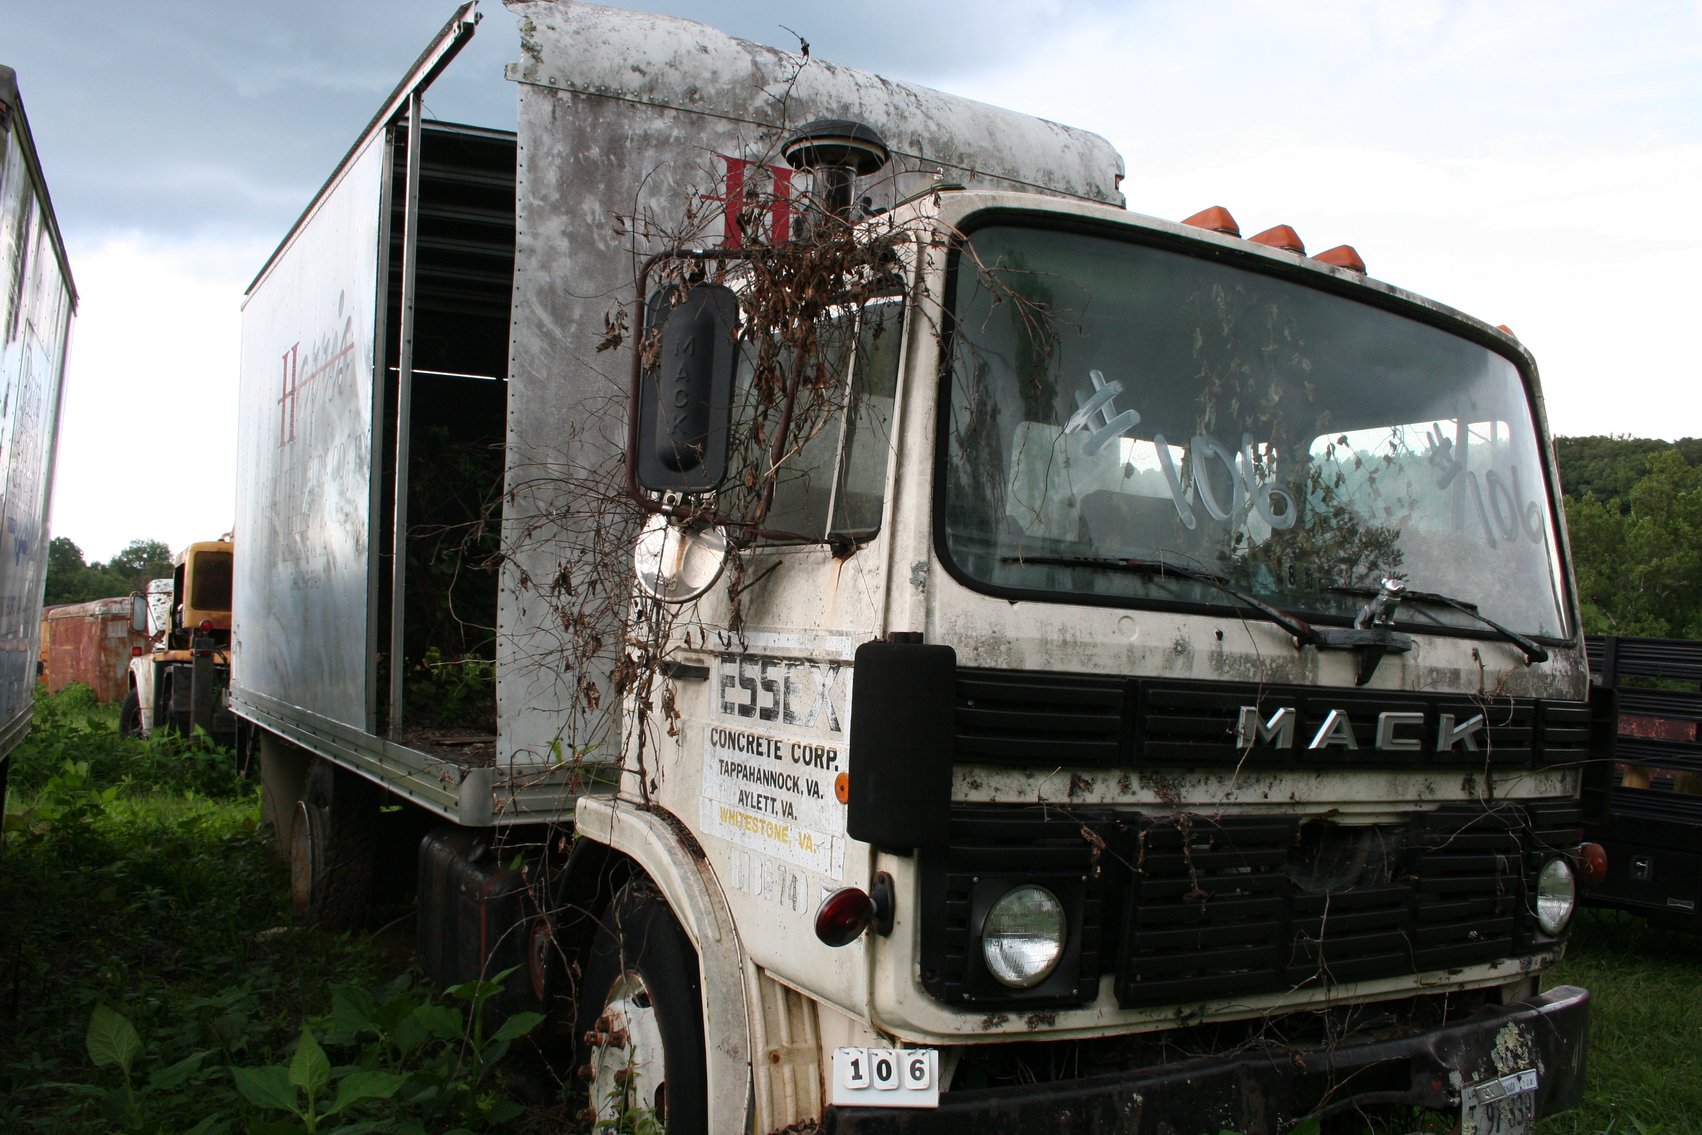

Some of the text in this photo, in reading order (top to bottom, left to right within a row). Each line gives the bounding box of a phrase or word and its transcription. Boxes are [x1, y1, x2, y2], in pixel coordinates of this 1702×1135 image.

[673, 335, 696, 436] MACK
[720, 655, 841, 732] ESSEX
[710, 728, 839, 772] CONCRETE CORP.
[1236, 705, 1484, 752] MACK
[719, 759, 824, 800] TAPPAHANNOCK, VA.
[737, 789, 797, 820] AYLETT, VA.
[720, 807, 817, 853] WHITESTONE, VA.
[850, 1058, 925, 1082] 106
